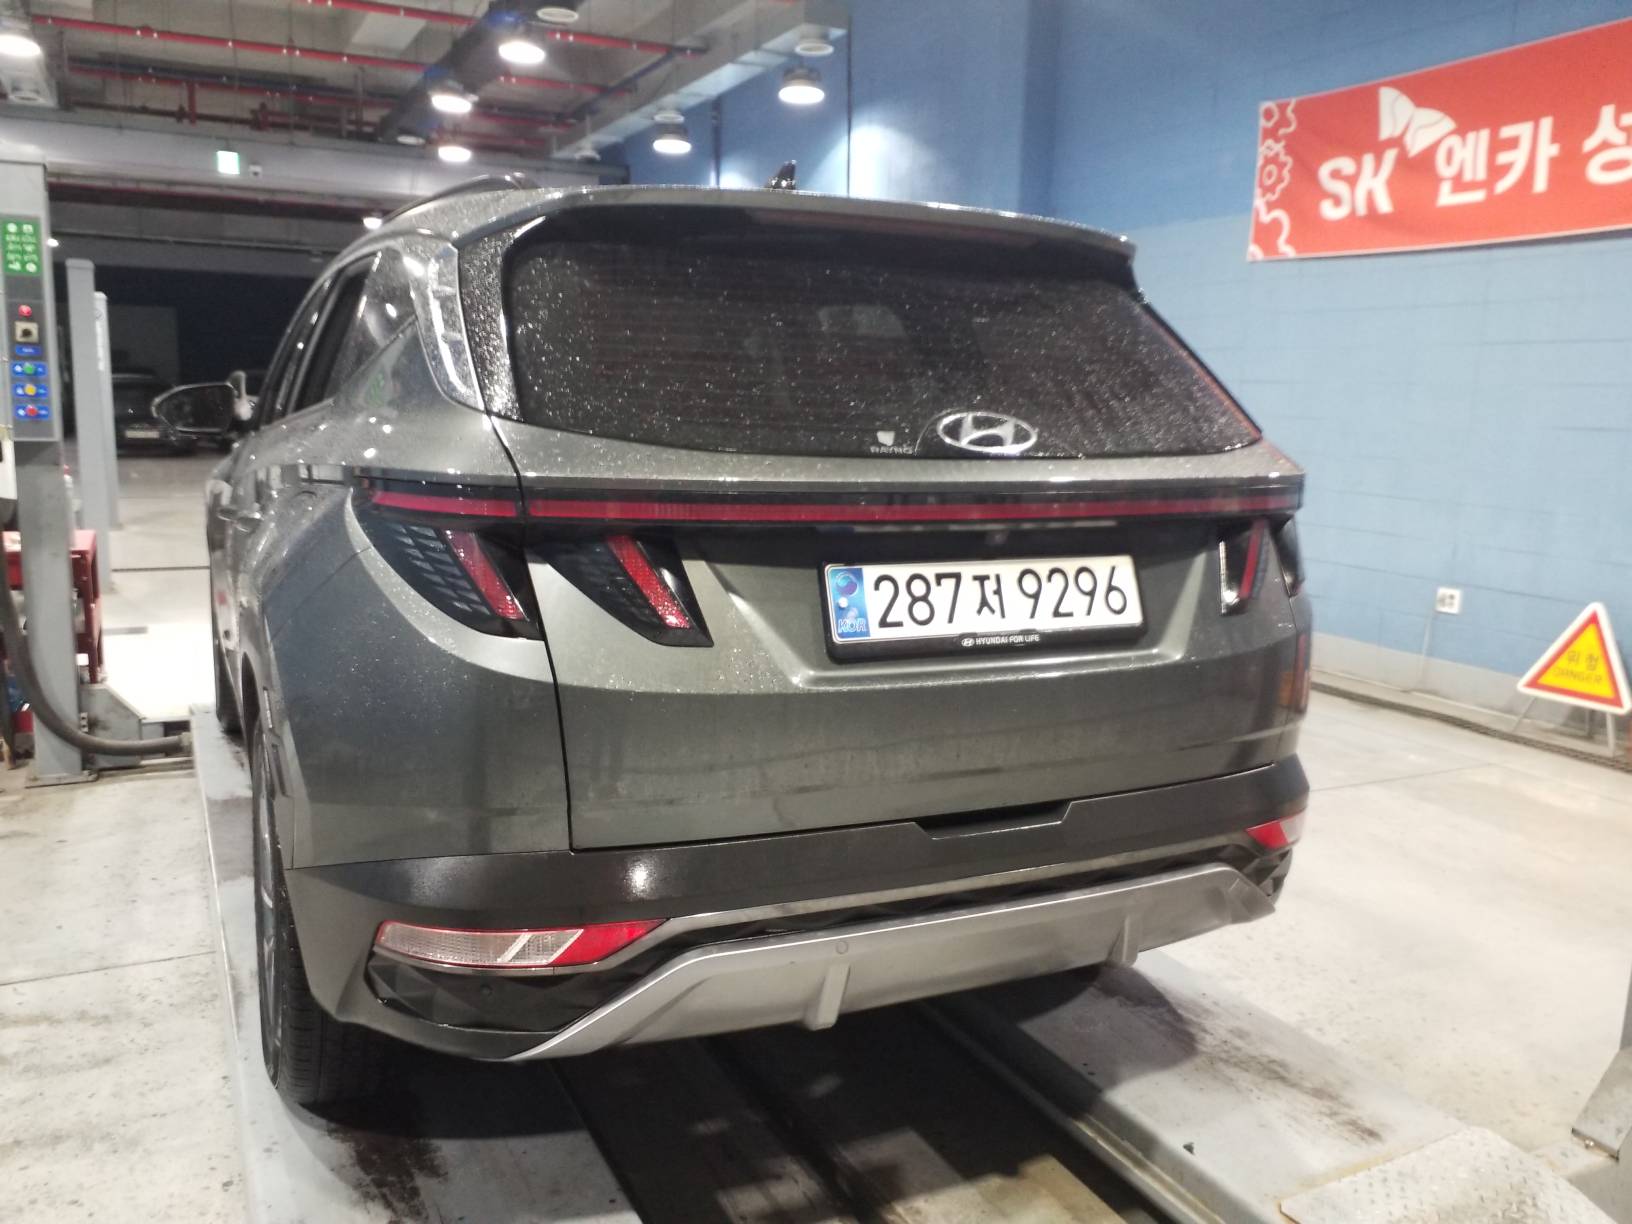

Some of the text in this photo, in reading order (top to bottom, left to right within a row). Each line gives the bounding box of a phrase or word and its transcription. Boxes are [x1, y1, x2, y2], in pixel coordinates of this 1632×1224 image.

[1317, 147, 1399, 221] SK
[1435, 116, 1560, 208] 엔카
[838, 618, 866, 633] KOR
[975, 634, 1040, 645] HYUNDAI FOR LIFE
